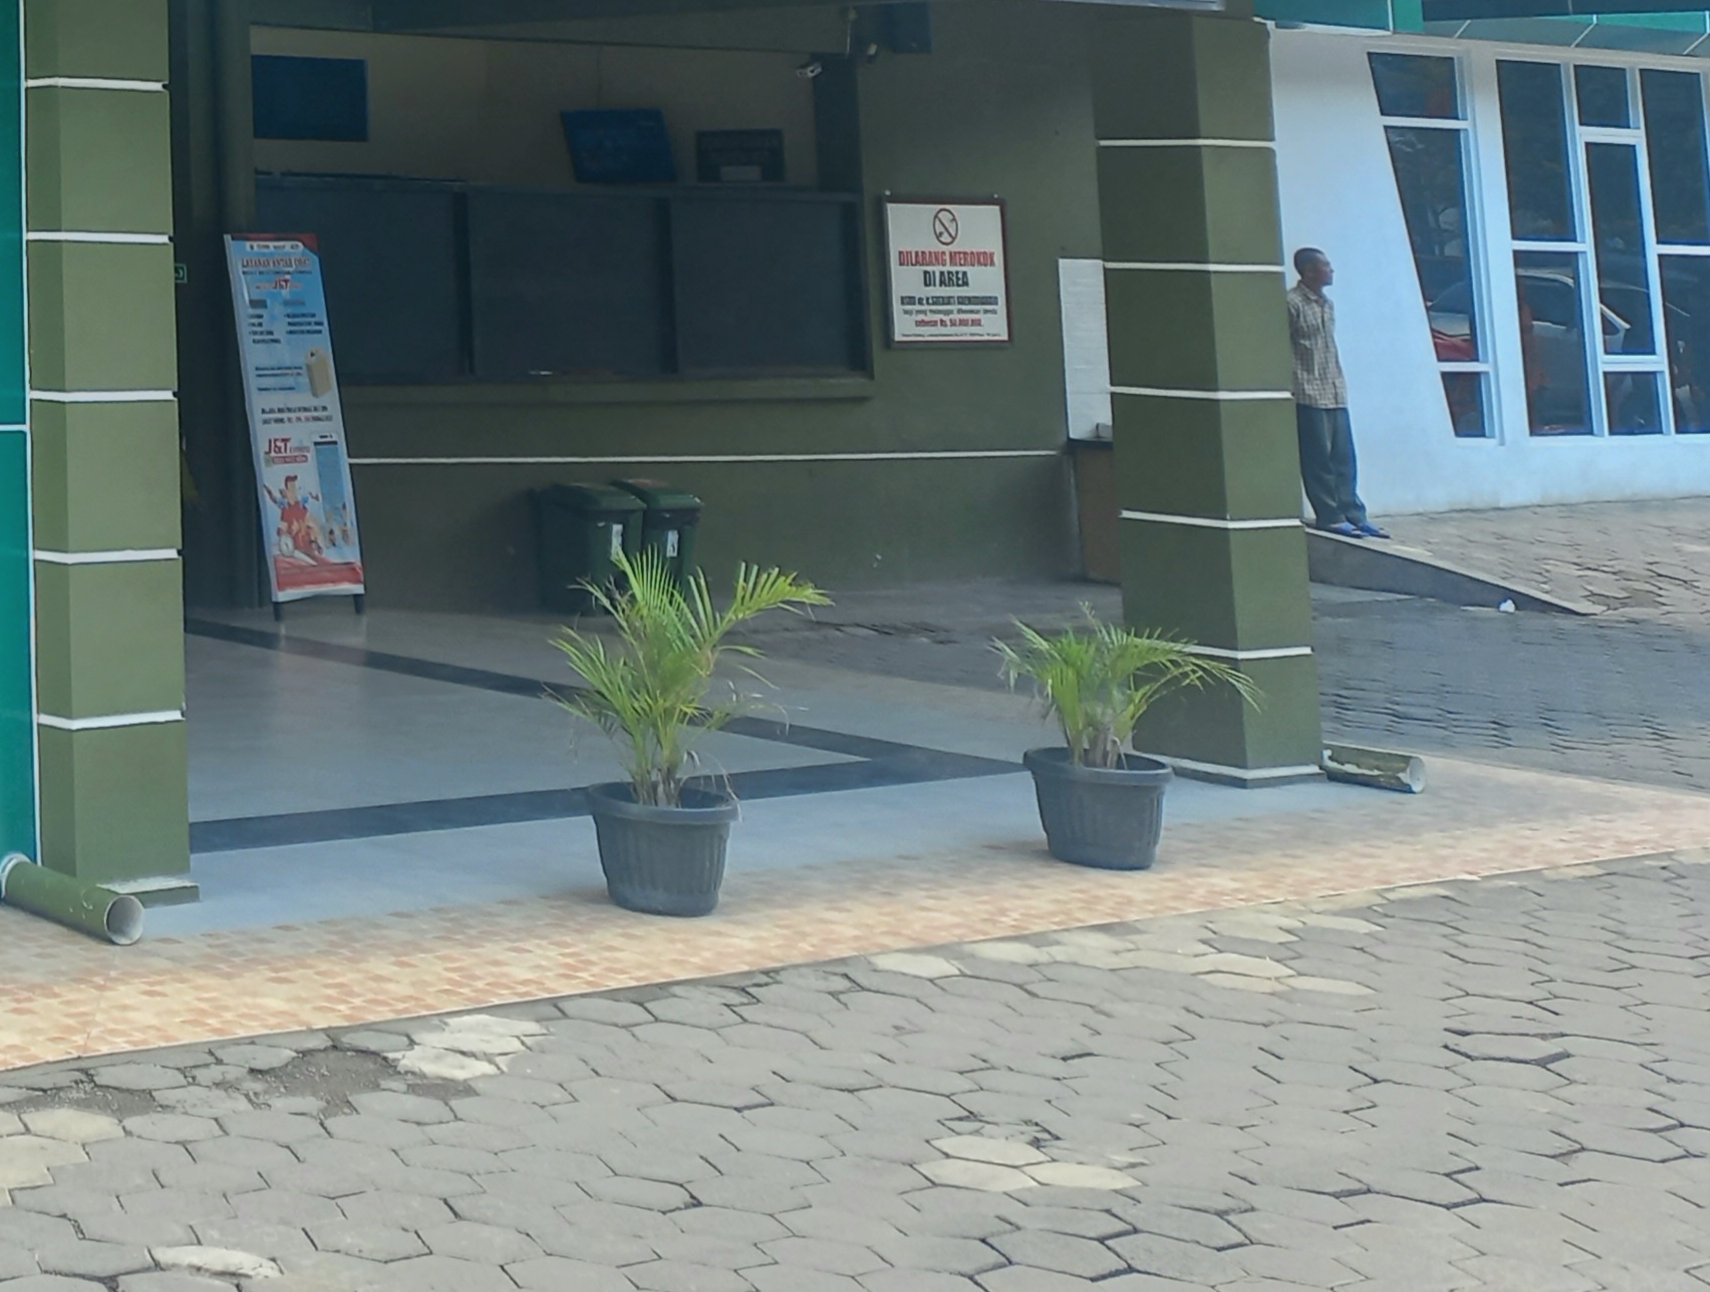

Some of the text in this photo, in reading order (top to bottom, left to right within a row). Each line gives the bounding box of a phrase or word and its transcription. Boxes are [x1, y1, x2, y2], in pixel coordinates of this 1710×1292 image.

[898, 251, 996, 267] DILARANG MEROKOK
[923, 270, 970, 287] DI AREA
[264, 437, 291, 455] J&T
